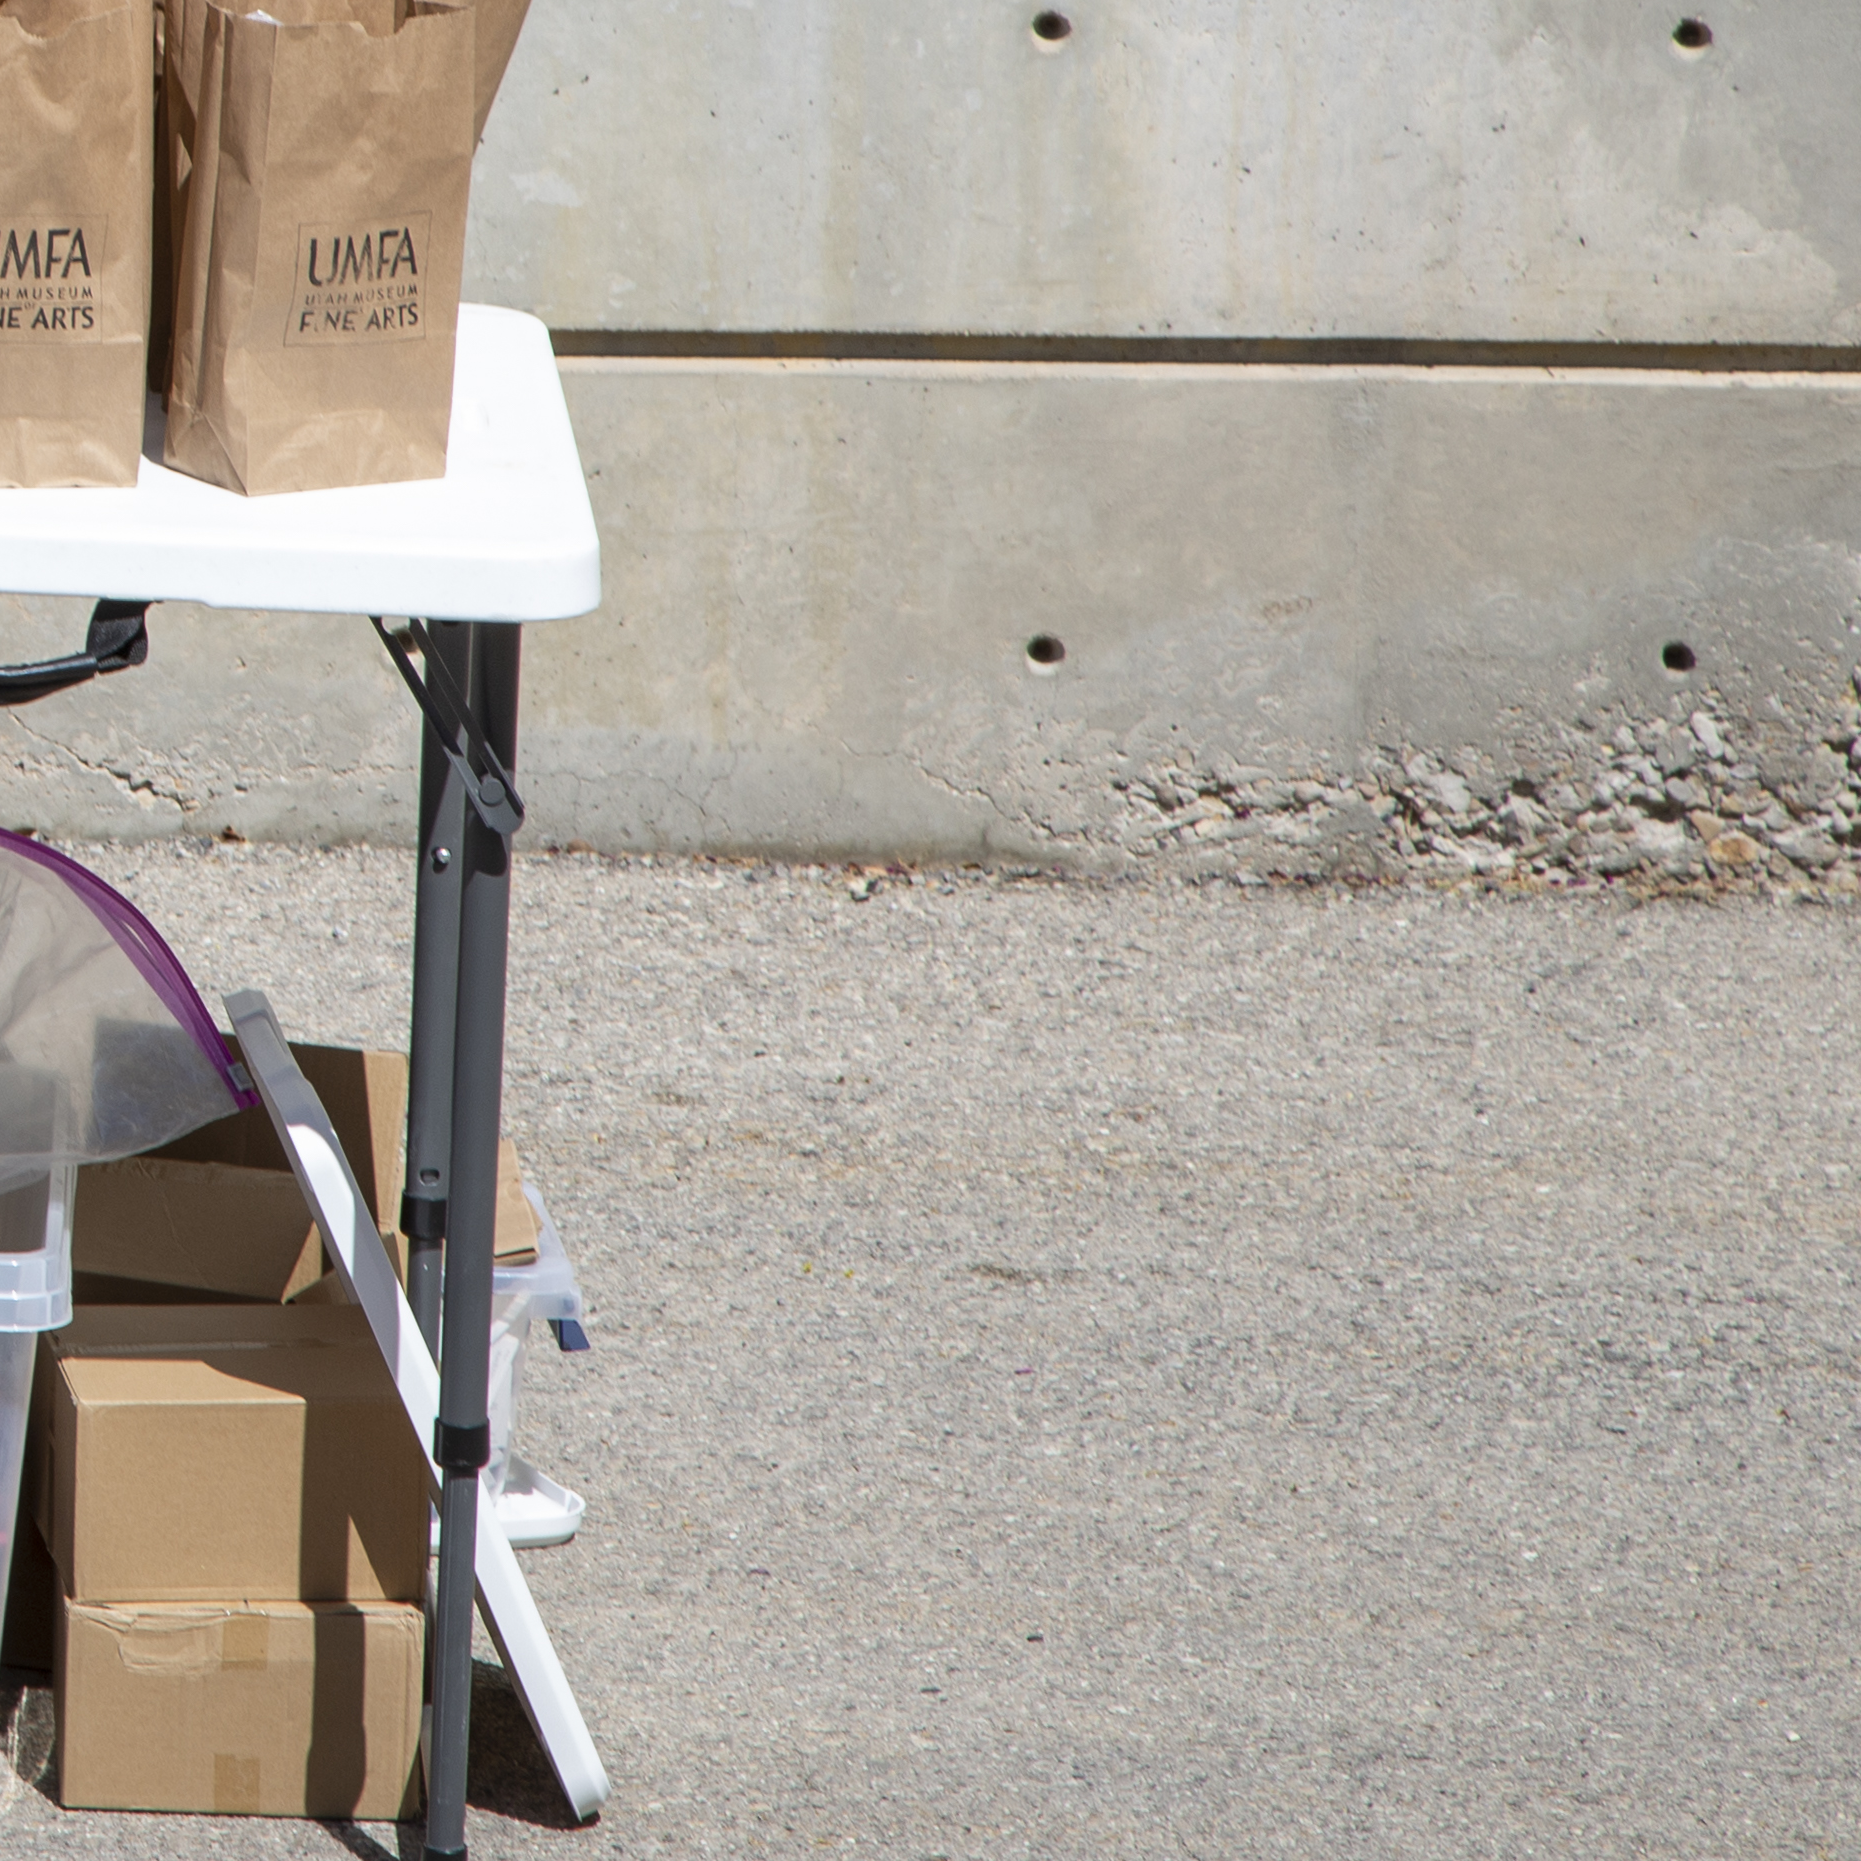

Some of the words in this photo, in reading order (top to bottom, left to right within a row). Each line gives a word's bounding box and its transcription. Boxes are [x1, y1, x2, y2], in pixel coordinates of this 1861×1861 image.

[308, 226, 418, 287] UMFA
[16, 286, 93, 300] MUSEUM
[353, 283, 418, 303] MUSEUM
[30, 306, 94, 330] ARTS
[299, 309, 357, 333] FNE
[365, 302, 419, 331] ARTS
